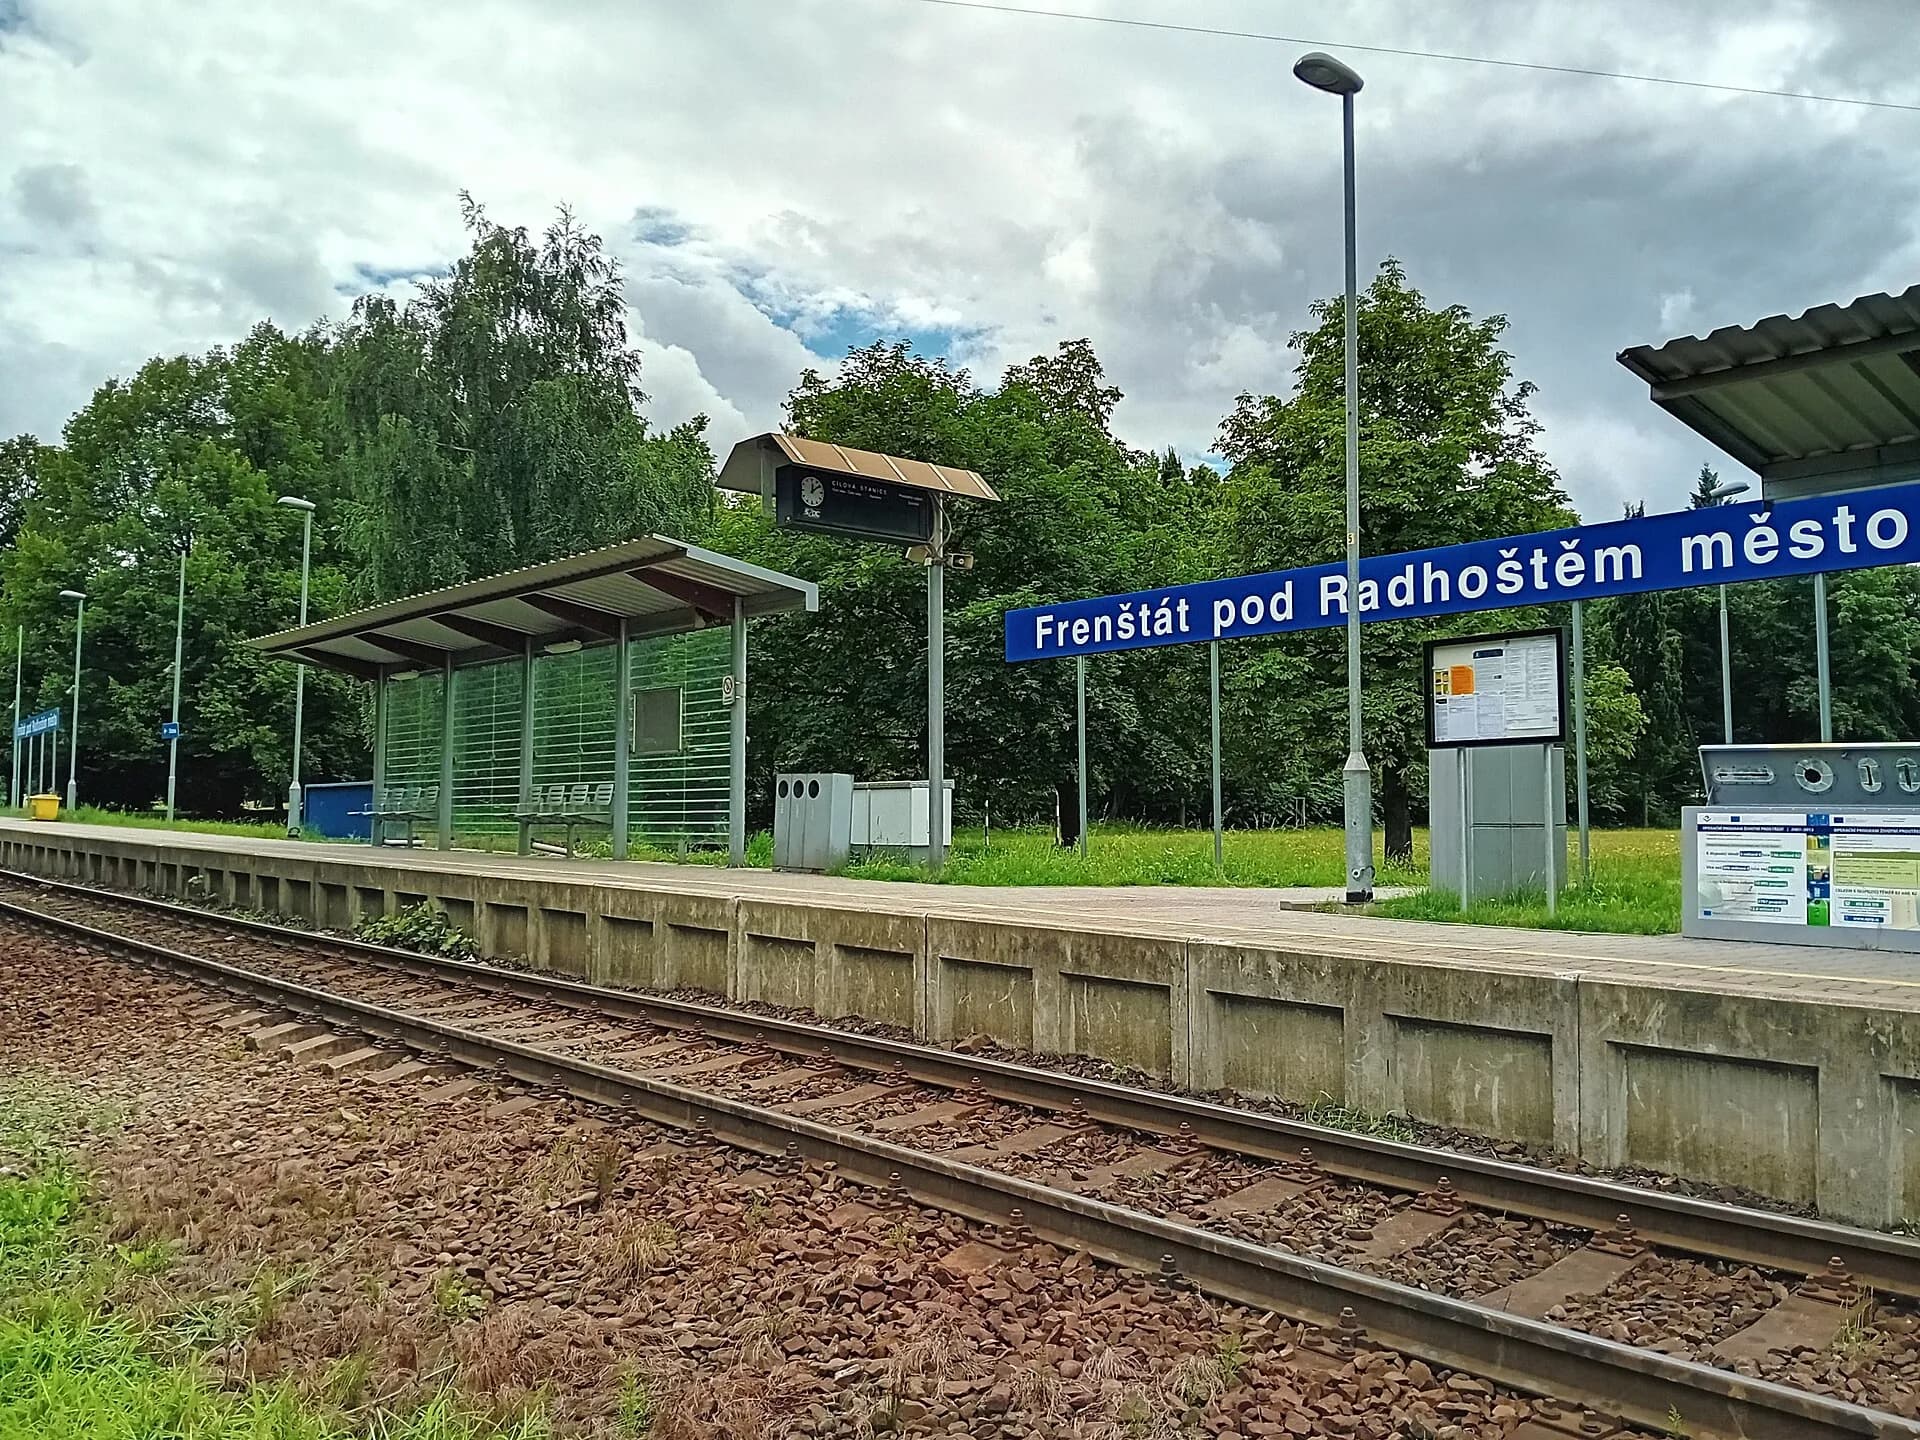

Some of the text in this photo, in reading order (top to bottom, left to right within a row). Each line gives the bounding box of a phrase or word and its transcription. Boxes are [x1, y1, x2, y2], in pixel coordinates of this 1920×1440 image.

[1035, 505, 1909, 649] Frenštát pod Radhoštěm město
